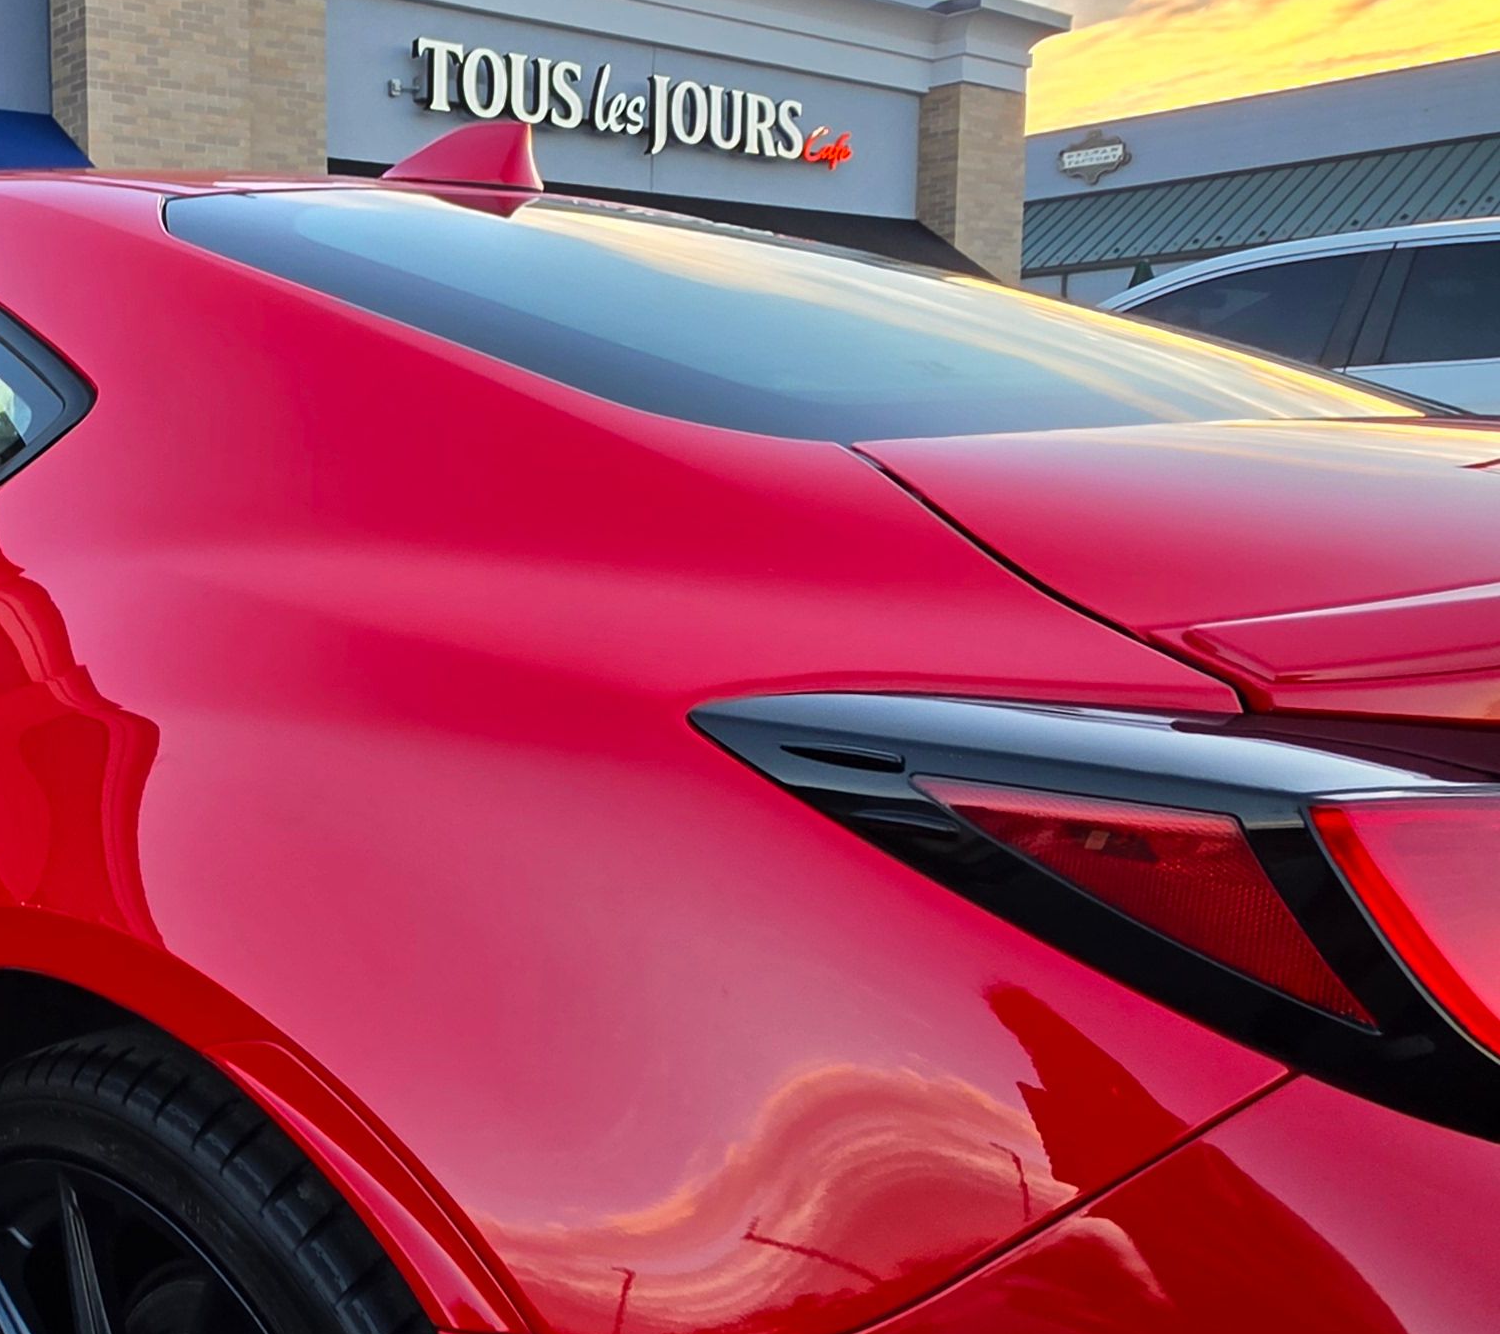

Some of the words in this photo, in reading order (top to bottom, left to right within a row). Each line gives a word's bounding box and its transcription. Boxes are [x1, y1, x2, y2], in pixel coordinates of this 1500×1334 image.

[416, 36, 582, 130] TOUS
[594, 63, 646, 136] les
[646, 73, 803, 160] JOURS
